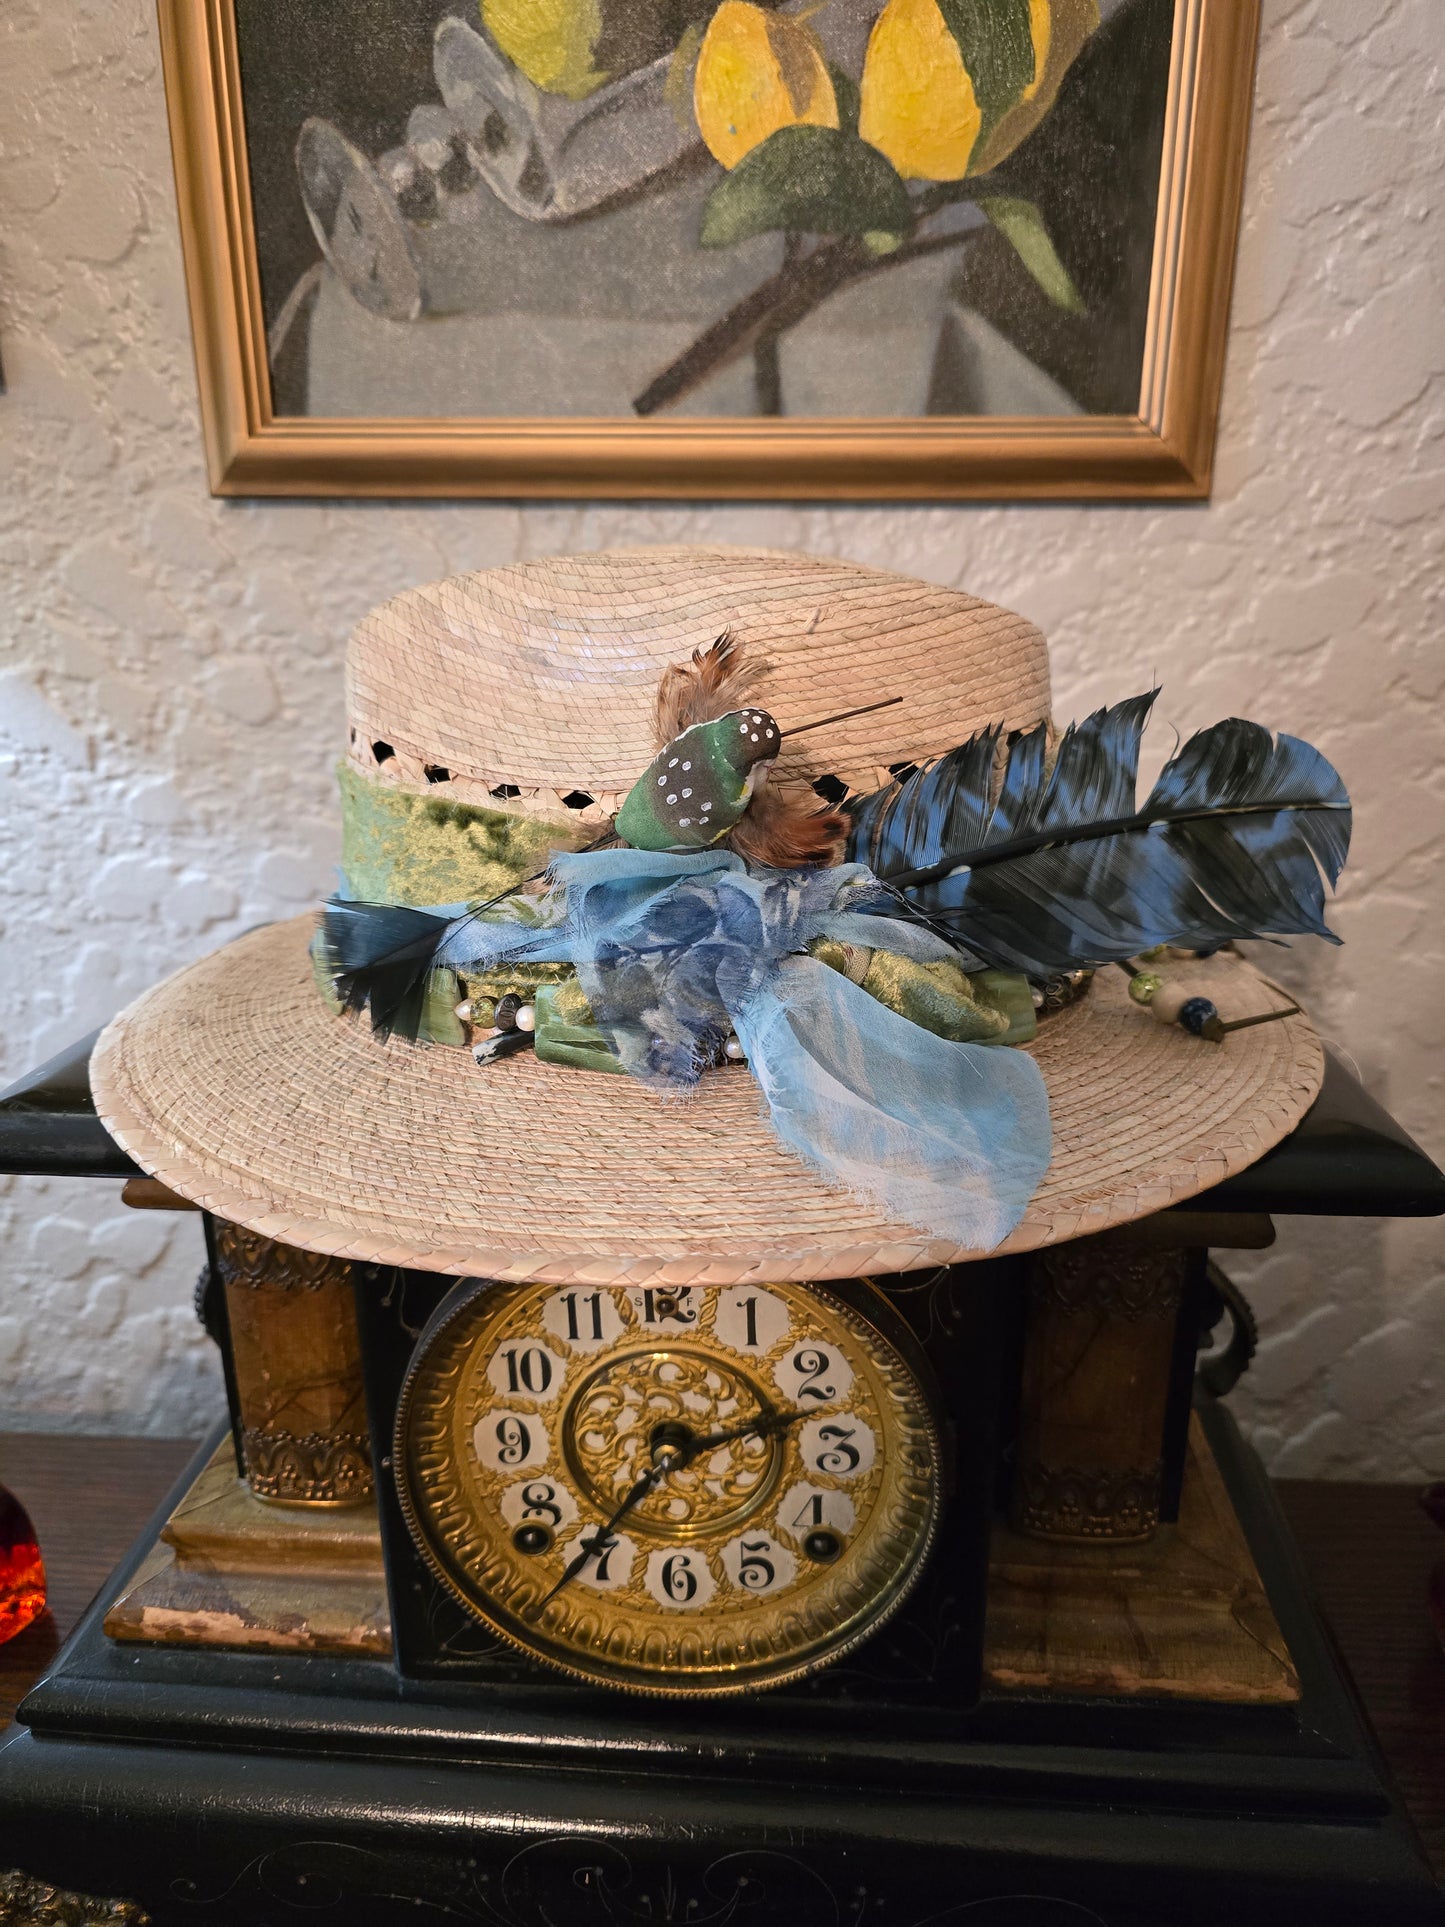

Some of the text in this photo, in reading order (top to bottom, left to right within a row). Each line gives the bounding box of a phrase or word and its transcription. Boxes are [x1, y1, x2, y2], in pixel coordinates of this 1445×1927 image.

[560, 1292, 604, 1340] 11
[633, 1296, 643, 1307] S
[686, 1297, 693, 1307] F
[735, 1296, 758, 1346] 1
[501, 1347, 553, 1393] 10
[793, 1349, 836, 1400] 2
[495, 1416, 531, 1464] 9
[816, 1424, 860, 1474] 3
[521, 1482, 563, 1527] 8
[791, 1494, 832, 1527] 4
[588, 1538, 620, 1581] 7
[661, 1554, 697, 1602] 6
[738, 1540, 775, 1588] 5
